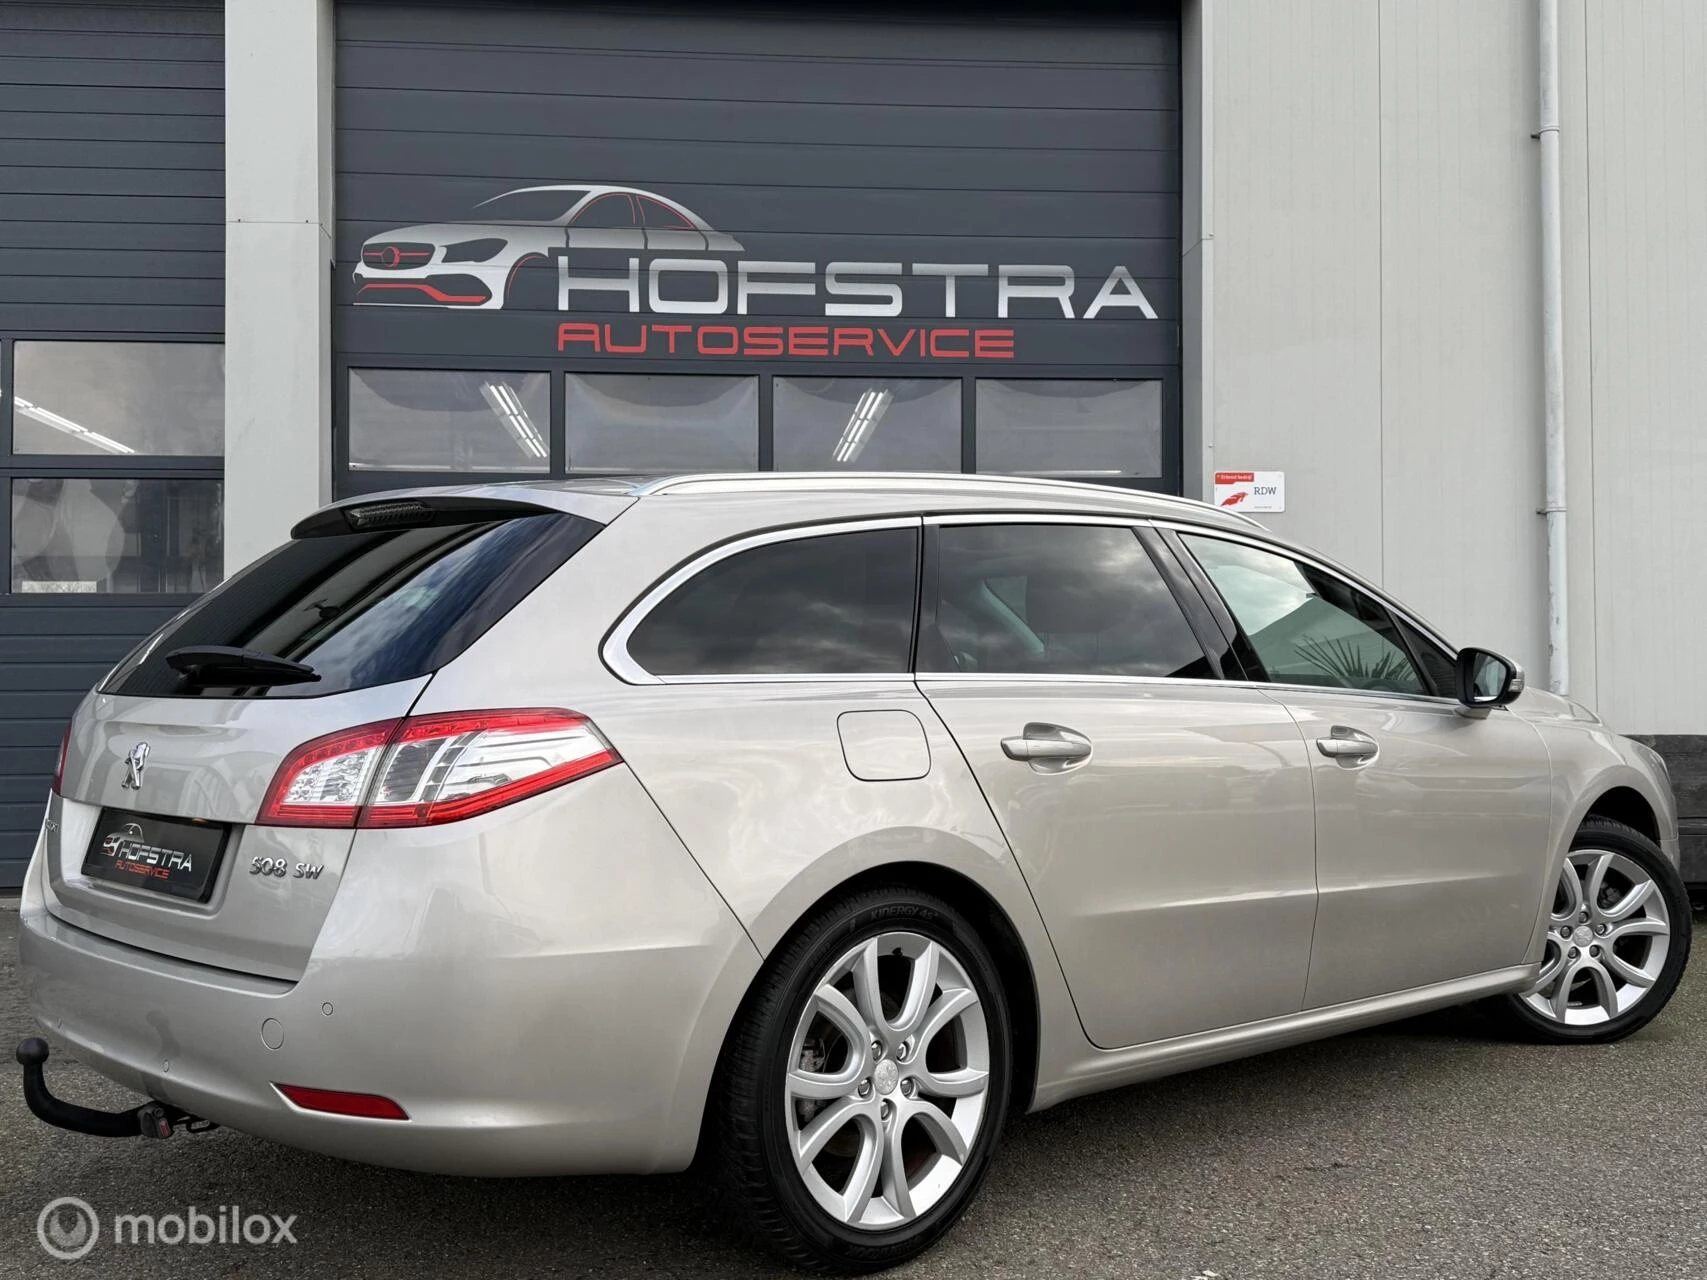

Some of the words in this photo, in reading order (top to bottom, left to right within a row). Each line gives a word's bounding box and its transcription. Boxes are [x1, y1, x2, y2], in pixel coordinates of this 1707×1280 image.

[557, 256, 1159, 319] HOFSTRA
[557, 322, 1014, 359] AUTOSERVICE
[1253, 486, 1277, 495] RDW
[114, 860, 171, 880] AUTOSERVICE
[118, 841, 192, 872] HOFSTRA
[249, 856, 287, 878] 508
[293, 862, 324, 880] SW
